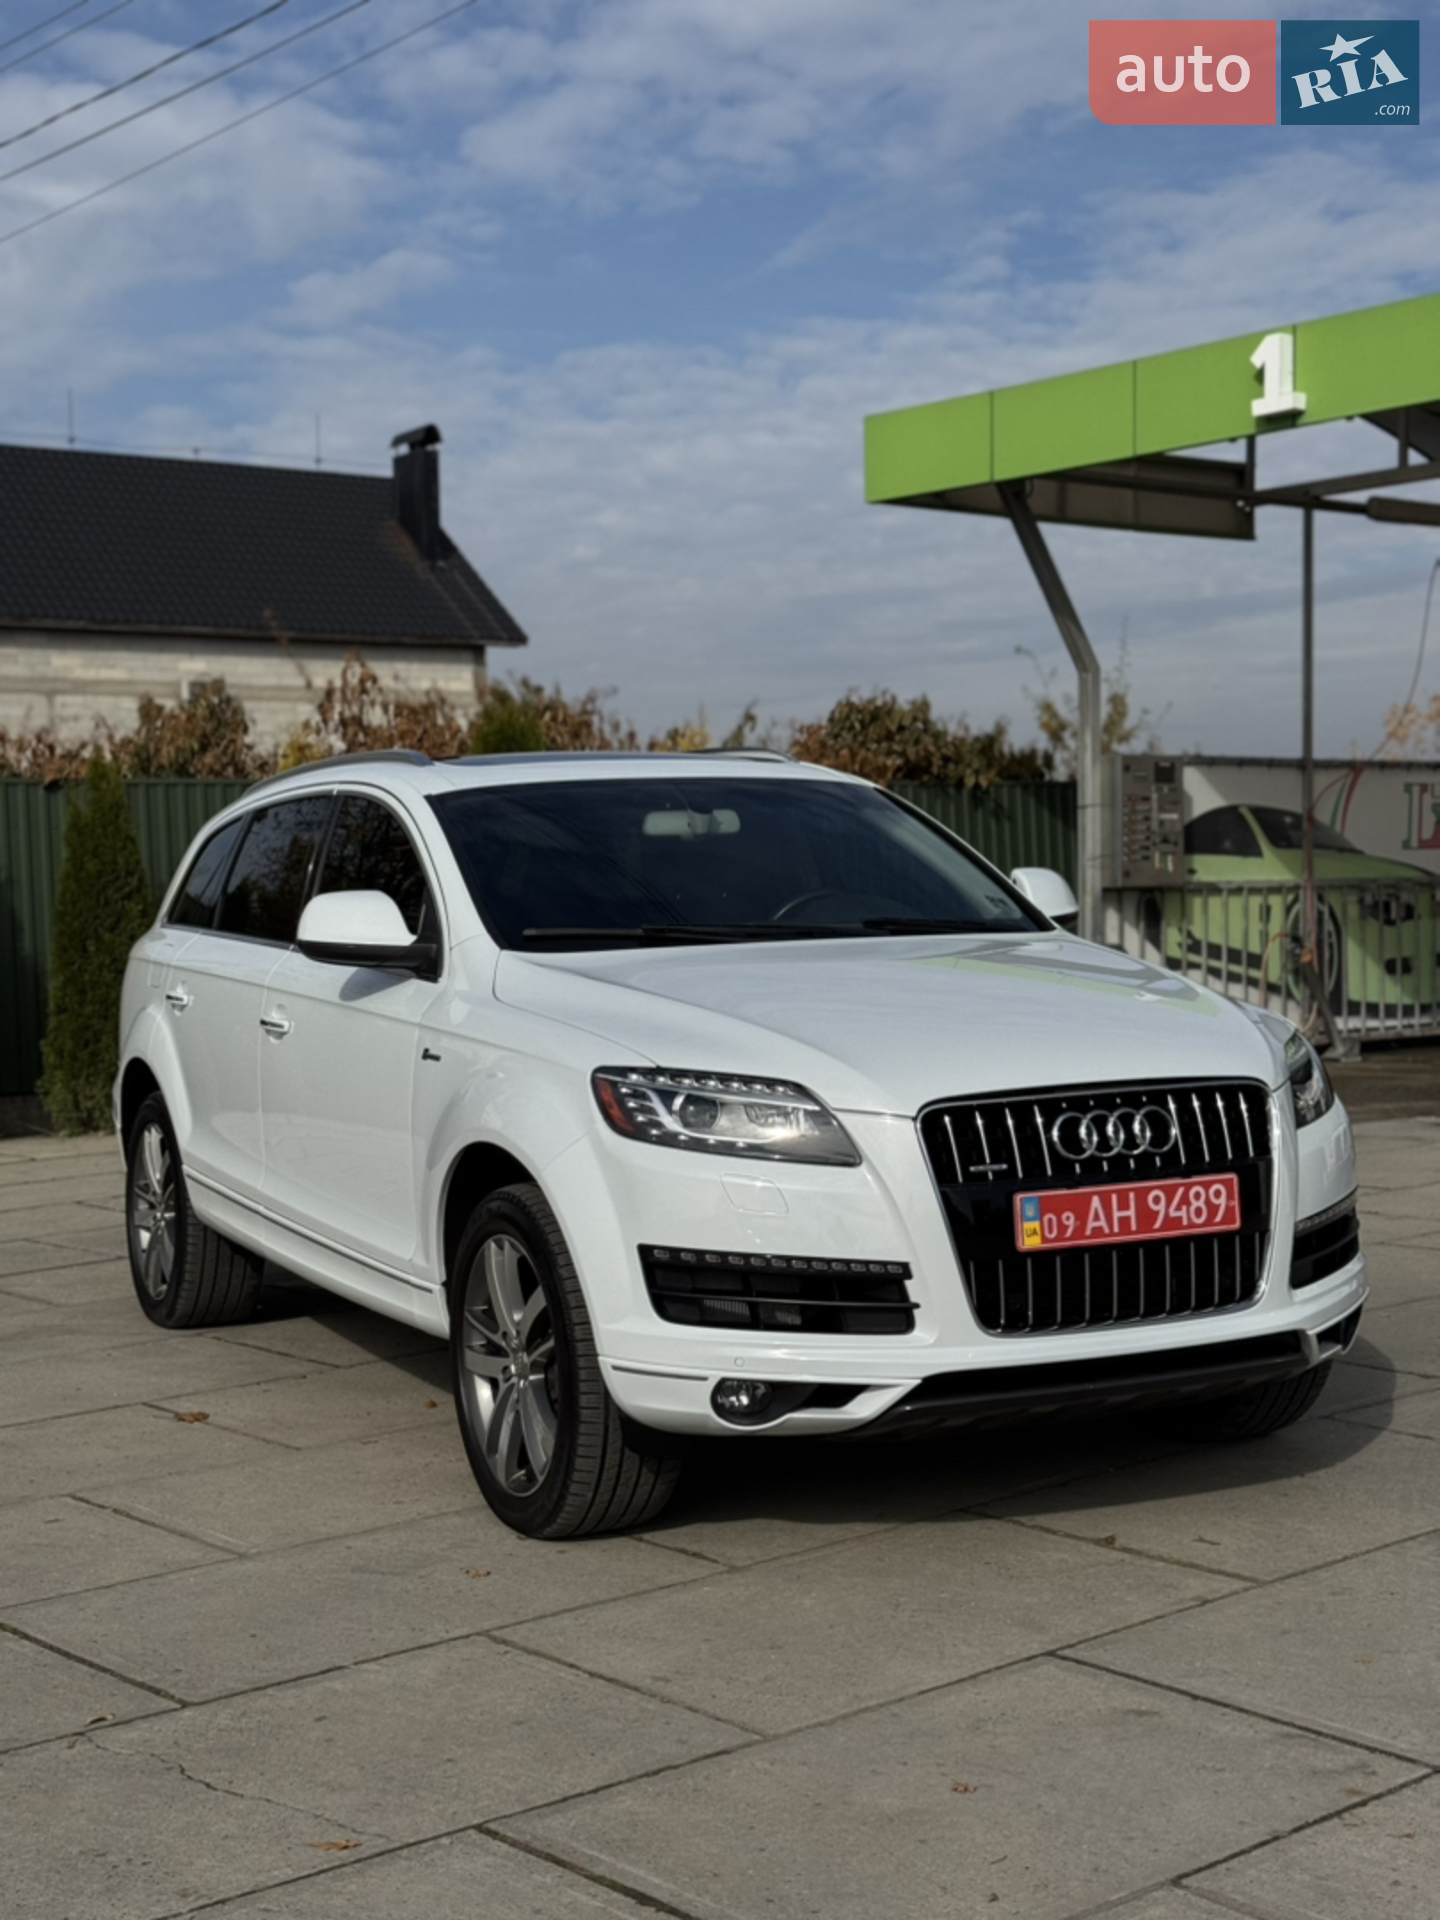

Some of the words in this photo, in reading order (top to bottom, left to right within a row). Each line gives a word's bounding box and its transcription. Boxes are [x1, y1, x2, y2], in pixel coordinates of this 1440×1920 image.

[1250, 332, 1307, 417] 1
[1025, 1227, 1039, 1238] UA
[1043, 1211, 1076, 1240] 09
[1084, 1191, 1137, 1236] AH
[1147, 1183, 1228, 1229] 9489
